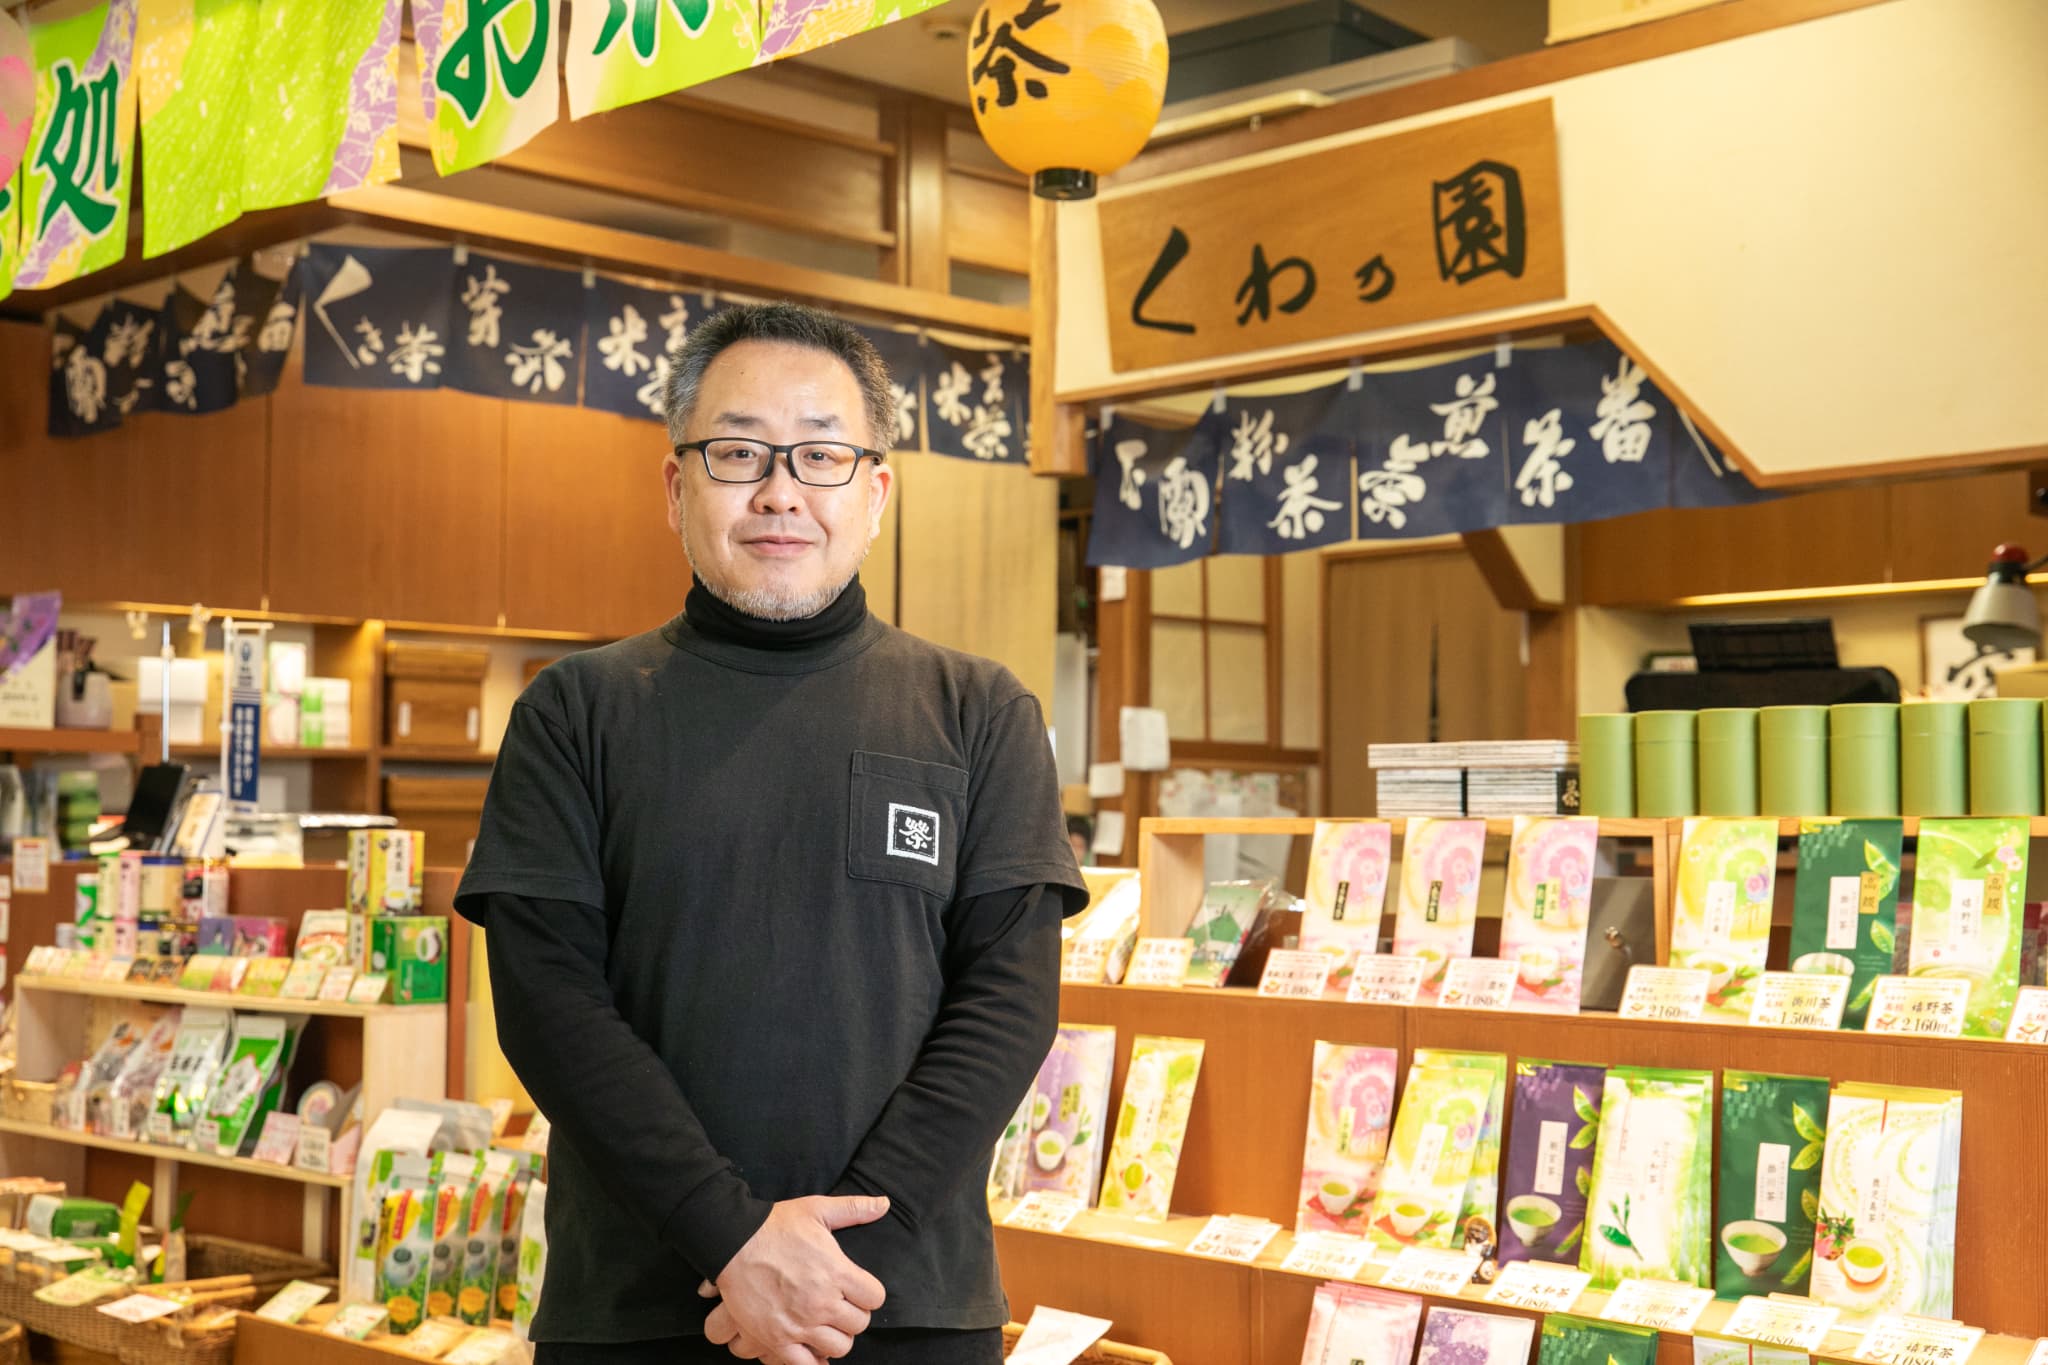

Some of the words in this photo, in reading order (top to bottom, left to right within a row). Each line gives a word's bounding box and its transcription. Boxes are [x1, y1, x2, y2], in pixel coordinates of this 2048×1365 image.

[35, 62, 119, 240] 処
[1906, 1342, 1954, 1359] 嬉野茶
